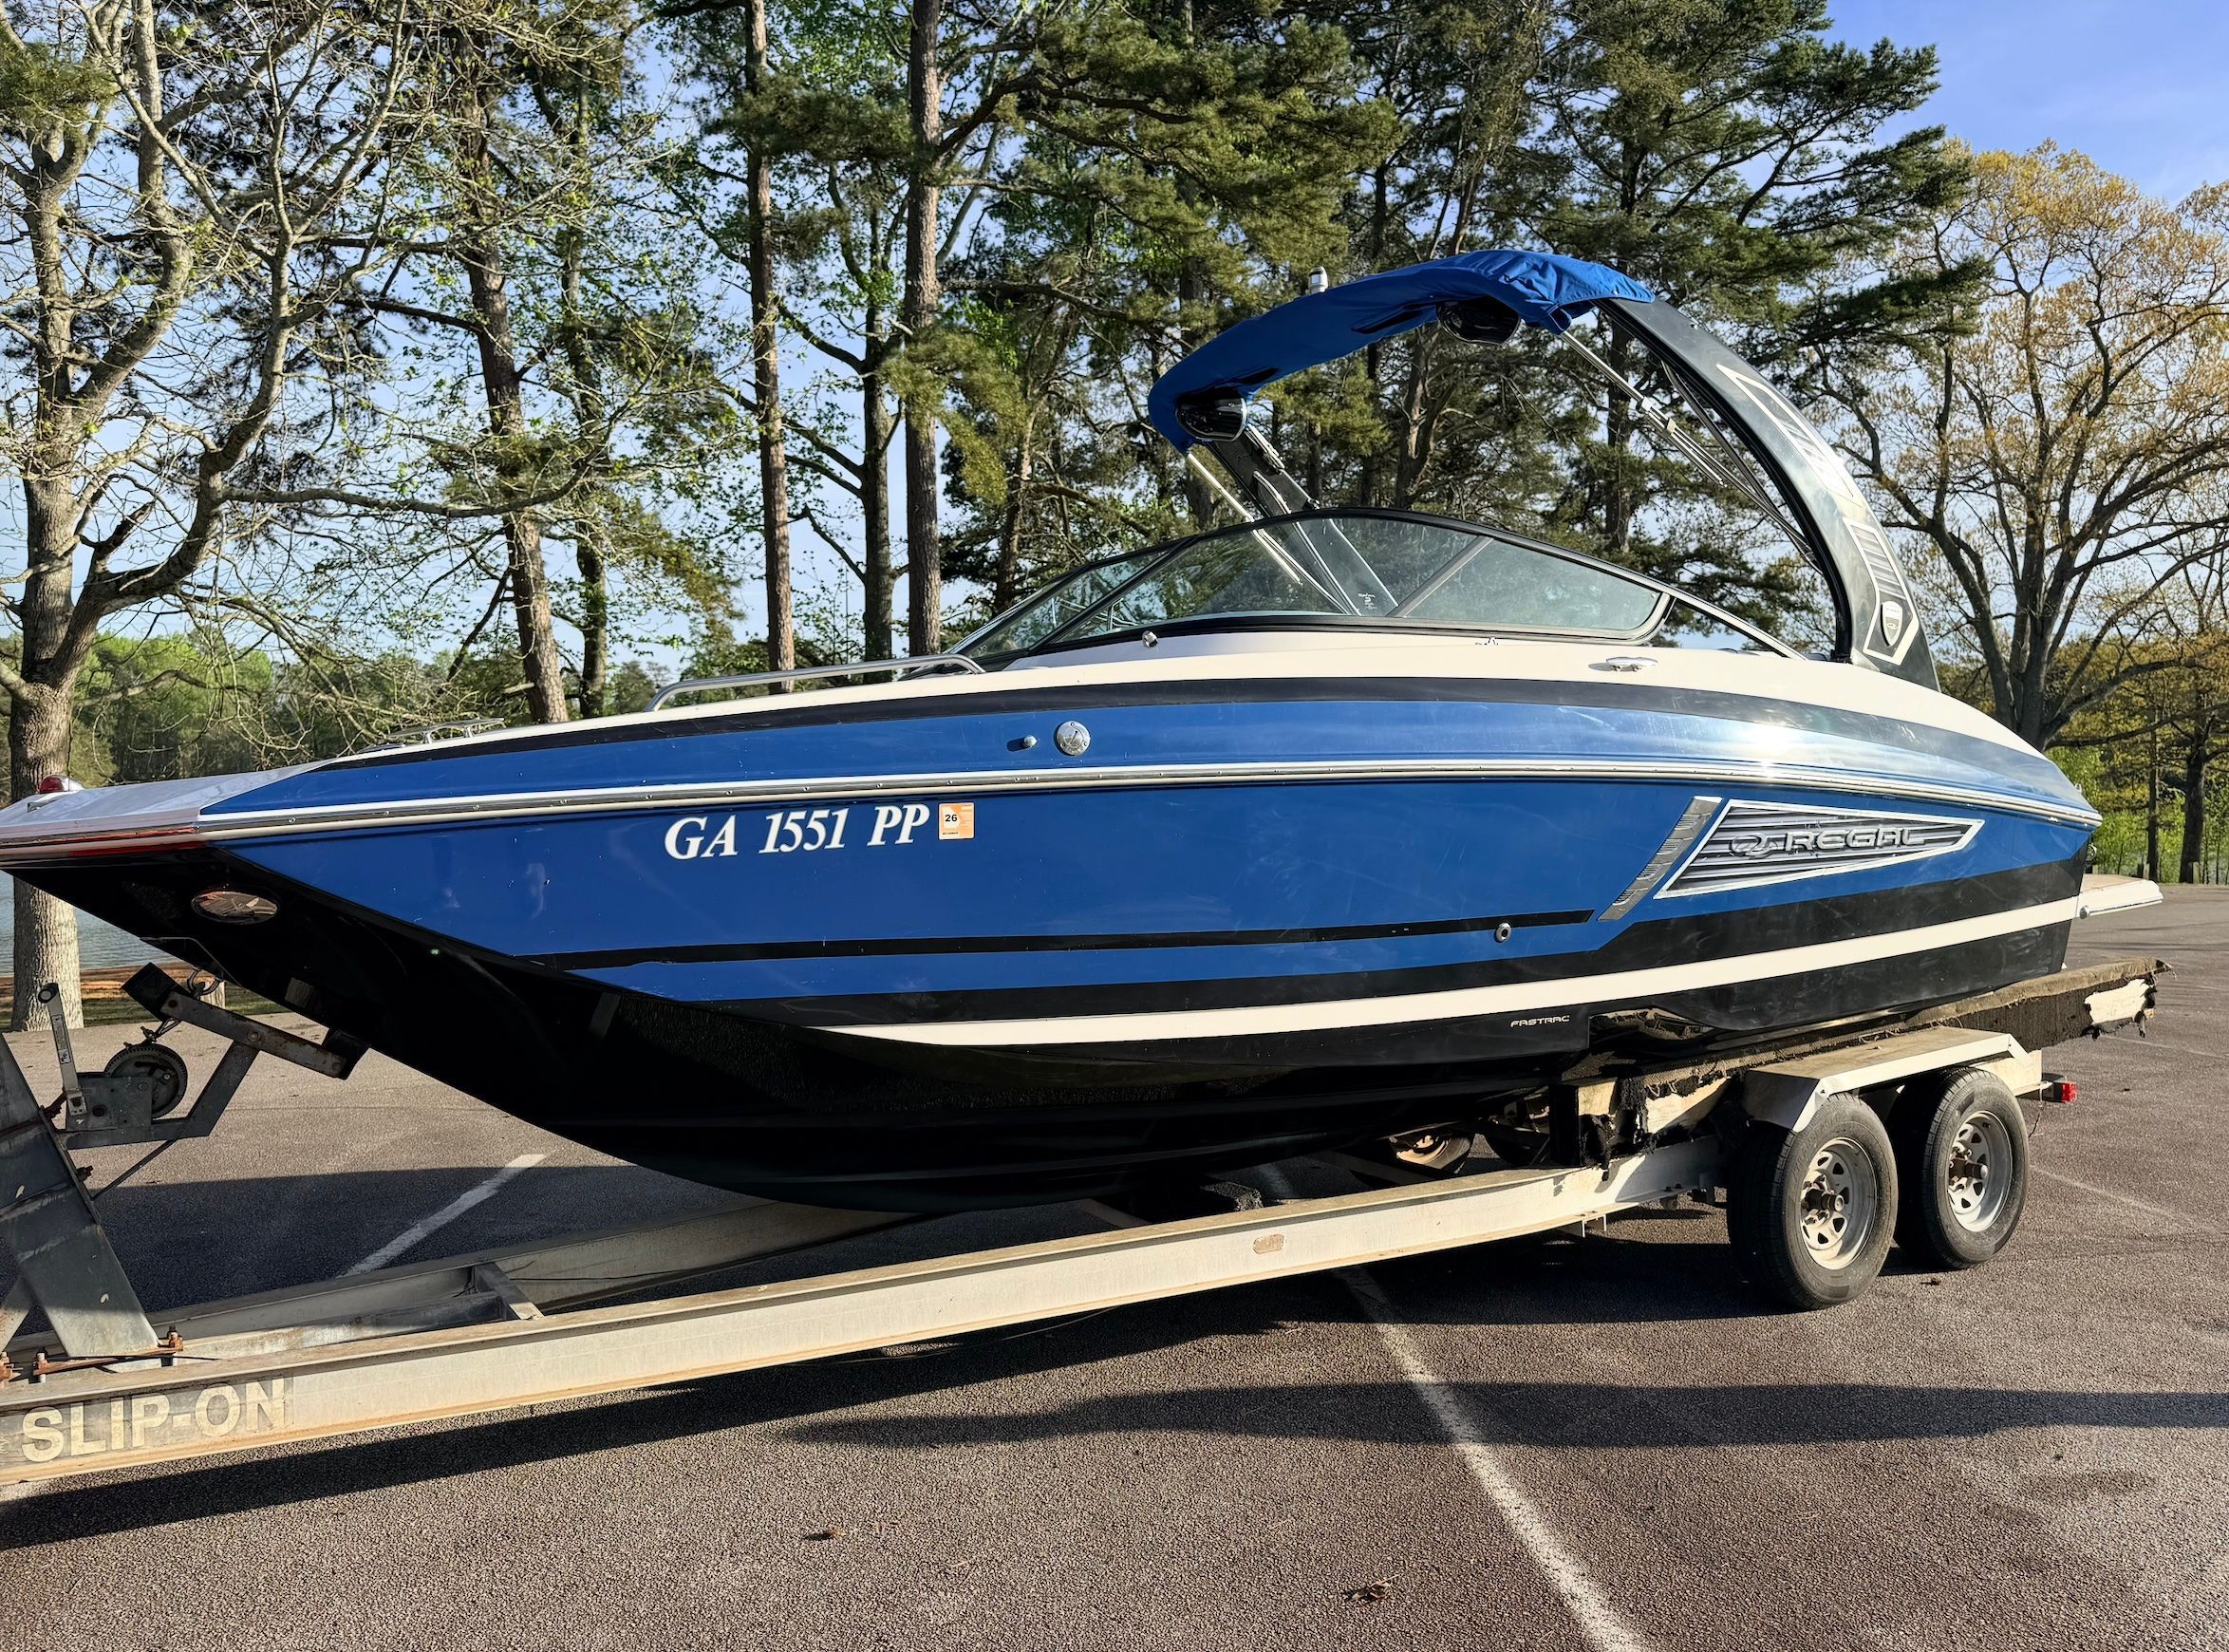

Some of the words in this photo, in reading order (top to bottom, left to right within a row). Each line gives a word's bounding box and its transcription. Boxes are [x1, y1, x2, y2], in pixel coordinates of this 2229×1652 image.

[945, 814, 958, 822] 26
[664, 815, 739, 860] GA
[759, 808, 850, 854] 1551
[867, 803, 930, 847] PP
[1786, 825, 1925, 851] REGAL
[1510, 1015, 1570, 1027] FASTRAC
[21, 1377, 286, 1462] SLIP-ON
